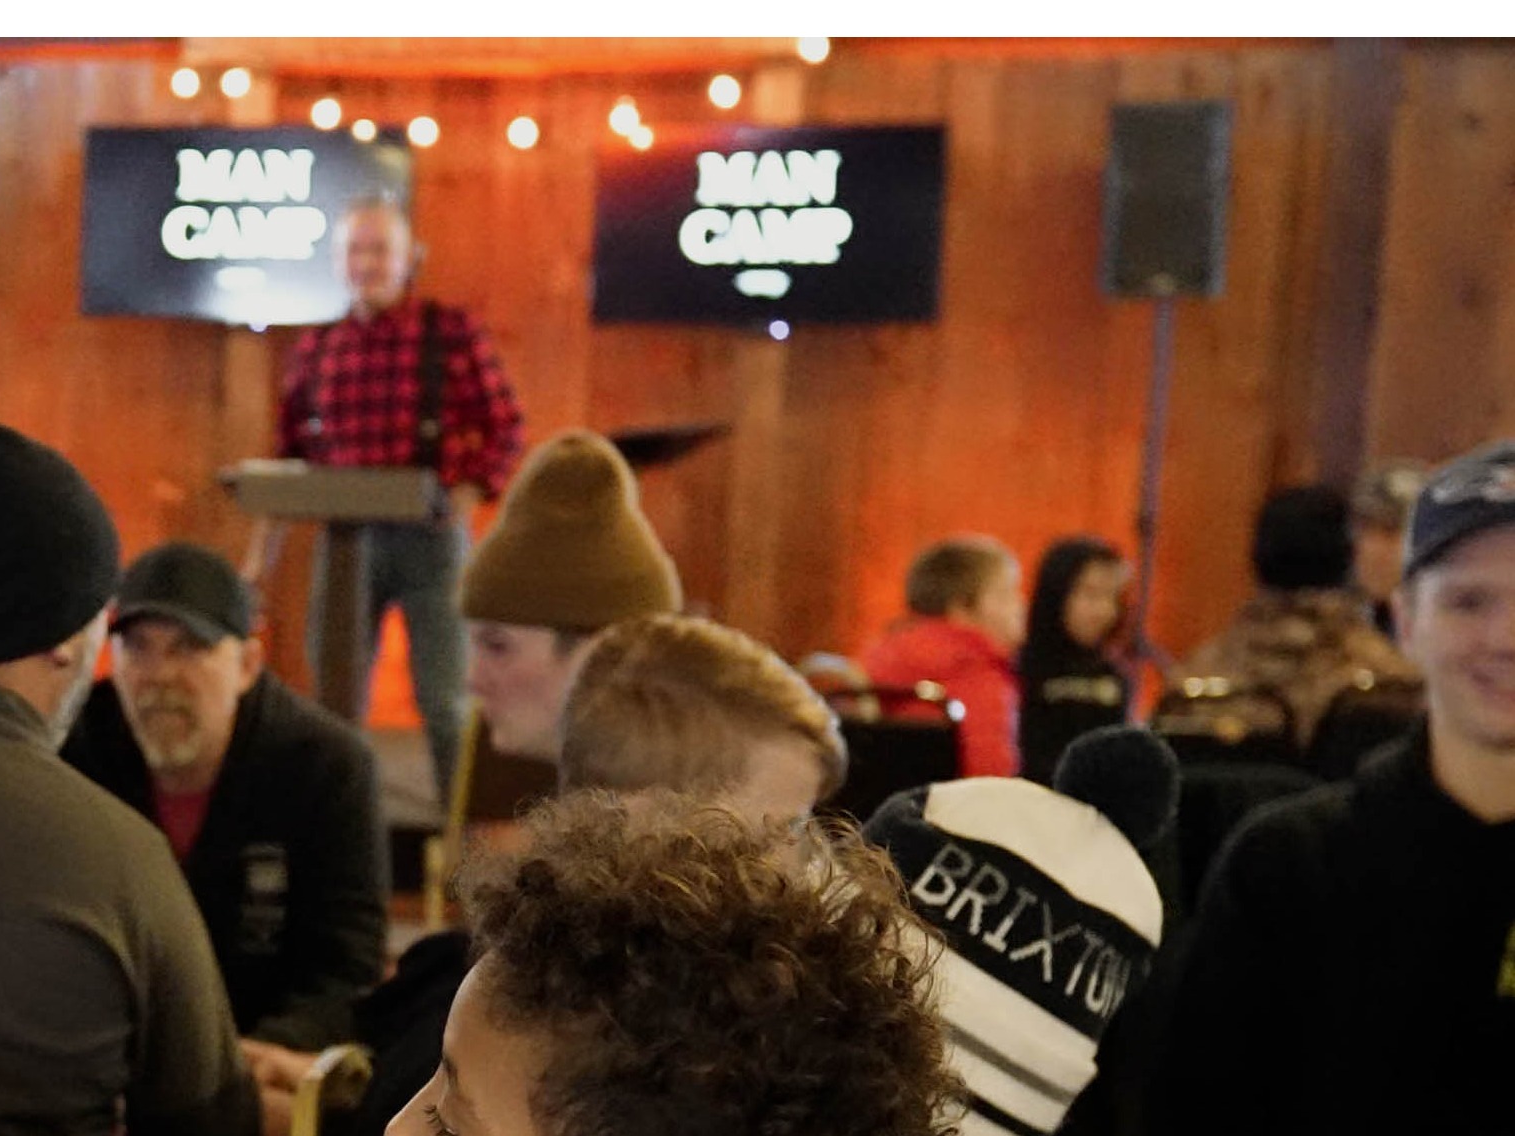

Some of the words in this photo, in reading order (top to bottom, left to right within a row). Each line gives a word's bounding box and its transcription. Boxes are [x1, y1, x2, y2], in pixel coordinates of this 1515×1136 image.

[177, 148, 314, 203] MAN
[697, 150, 840, 207] MAN
[161, 204, 327, 260] CAMP
[679, 207, 853, 265] CAMP
